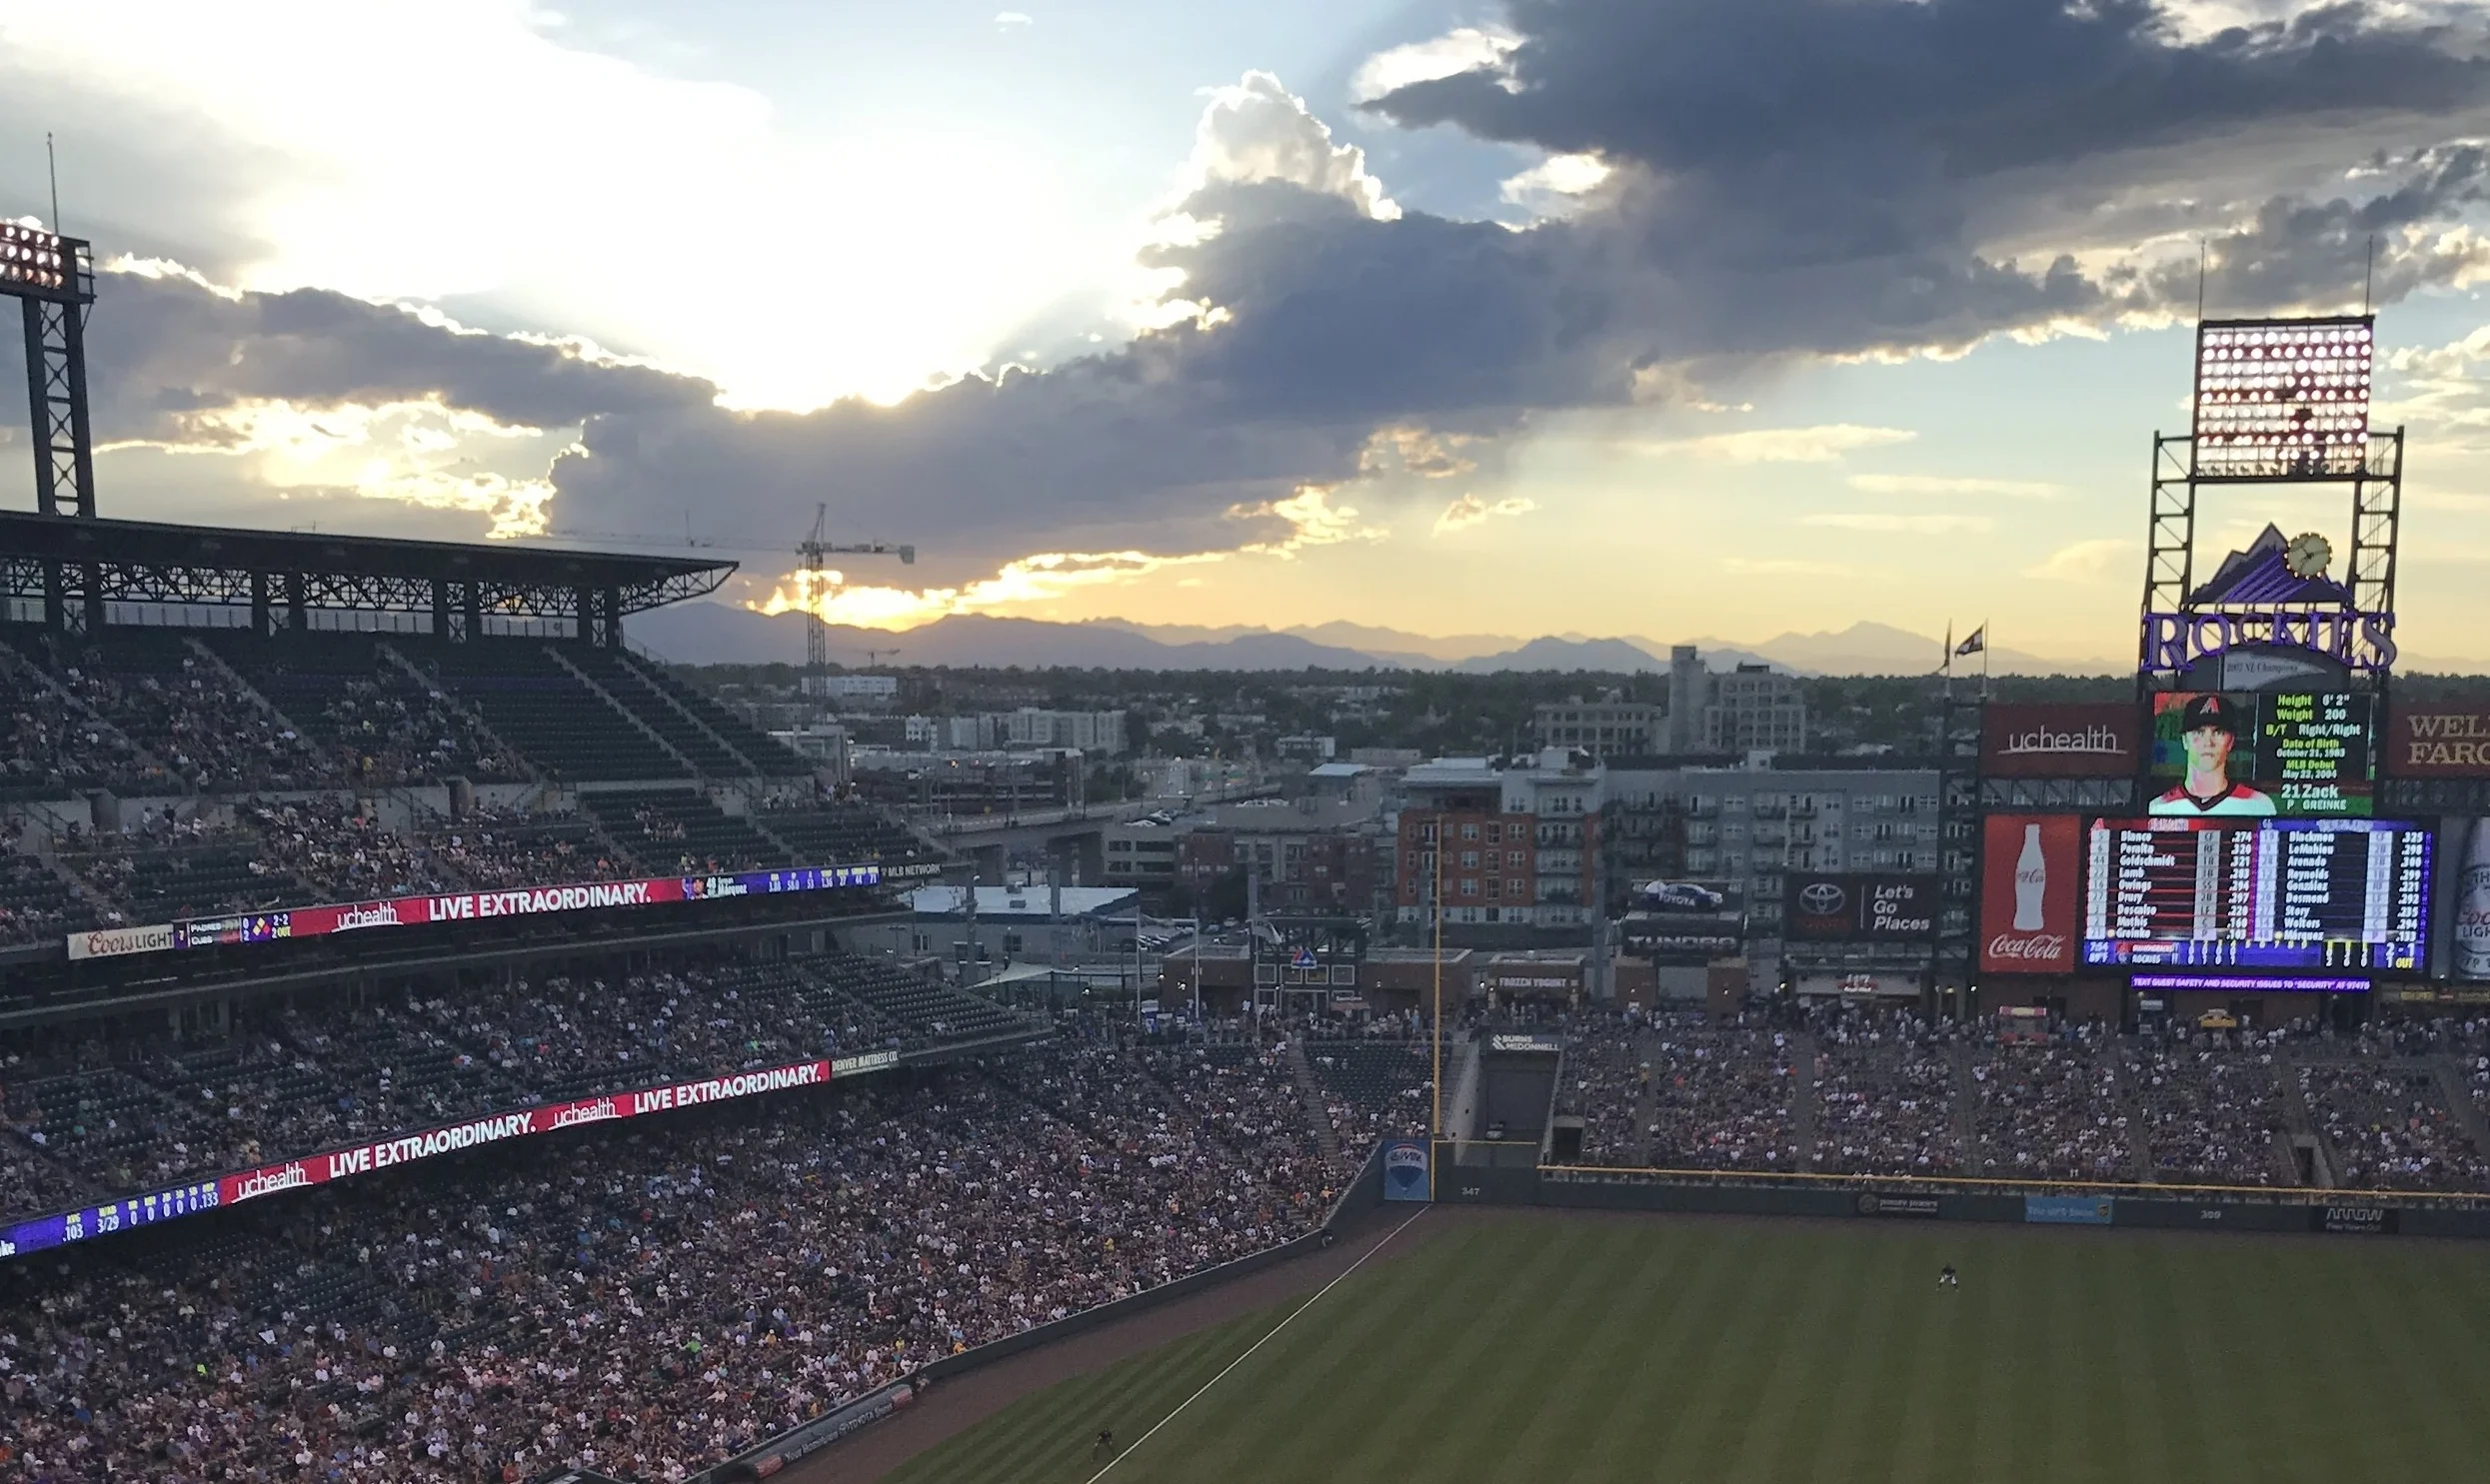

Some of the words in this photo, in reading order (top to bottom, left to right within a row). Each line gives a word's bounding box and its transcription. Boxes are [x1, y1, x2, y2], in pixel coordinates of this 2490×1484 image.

[2142, 613, 2398, 672] ROCKIES
[2277, 695, 2312, 708] Height
[2322, 695, 2333, 706] 6'
[2335, 695, 2350, 706] 2"
[2277, 710, 2313, 722] Weight
[2325, 710, 2347, 720] 200
[2265, 724, 2287, 738] B/T
[2299, 724, 2361, 738] Right/Right
[2407, 715, 2490, 738] WEL
[2009, 725, 2117, 750] uchealth
[2277, 748, 2309, 757] October
[2325, 748, 2345, 757] 1983
[2286, 760, 2306, 769] MLB
[2308, 760, 2335, 769] Debut
[2282, 769, 2299, 780] May
[2315, 769, 2337, 778] 2004
[2281, 783, 2300, 798] 21
[2301, 783, 2339, 798] Zack
[2287, 799, 2294, 809] P
[2303, 799, 2347, 809] GREINKE
[2120, 831, 2152, 841] Blanco
[2232, 831, 2252, 842] .274
[2289, 831, 2335, 842] Blackmon
[2402, 831, 2423, 842] .325
[2120, 843, 2154, 853] Peralta
[2231, 843, 2251, 854] .320
[2289, 843, 2334, 854] LeMahieu
[2119, 855, 2175, 866] Goldschmidt
[2231, 856, 2250, 866] .321
[2288, 856, 2327, 866] Arenado
[2401, 856, 2422, 867] .300
[889, 866, 904, 877] MLB
[905, 865, 942, 875] NETWORK
[2119, 867, 2145, 877] Lamb
[2287, 868, 2329, 881] Reynolds
[2400, 869, 2421, 880] .299
[1874, 884, 1913, 899] Let's
[2118, 880, 2151, 892] Owings
[2399, 881, 2419, 892] .221
[429, 895, 474, 921] LIVE
[479, 882, 652, 917] EXTRAORDINARY.
[1659, 893, 1695, 906] TOYOTA
[2118, 892, 2143, 904] Drury
[2286, 893, 2329, 903] Desmond
[2398, 893, 2419, 904] .292
[1873, 900, 1897, 914] Go
[2117, 904, 2157, 915] Descalso
[2285, 906, 2310, 918] Story
[2397, 906, 2418, 917] .235
[273, 914, 289, 925] 2-2
[337, 901, 397, 929] uchealth
[190, 922, 221, 932] PADRES
[243, 918, 249, 927] 0
[1873, 916, 1930, 930] Places
[2117, 917, 2148, 927] Mathis
[2284, 918, 2321, 929] Wolters
[2397, 918, 2418, 929] .294
[243, 930, 249, 941] 2
[272, 929, 277, 939] 2
[277, 926, 291, 937] OUT
[2116, 928, 2151, 938] Greinke
[2396, 930, 2417, 941] .133
[87, 931, 133, 955] Coors
[136, 931, 174, 948] LIGHT
[1989, 933, 2066, 959] Coca-Cola
[2386, 942, 2394, 956] 2
[2407, 942, 2415, 957] 1
[2386, 957, 2392, 968] 1
[2396, 957, 2413, 968] OUT
[1499, 977, 1531, 986] FROZEN
[1533, 978, 1566, 987] YOGURT
[2133, 977, 2151, 986] TEXT
[2151, 978, 2175, 987] GUEST
[2176, 978, 2202, 987] SAFETY
[2221, 979, 2255, 988] SECURITY
[2336, 980, 2346, 989] AT
[832, 1057, 857, 1071] DENVER
[858, 1052, 888, 1066] MATTRESS
[889, 1051, 899, 1061] CO.
[554, 1097, 616, 1125] uchealth
[634, 1089, 673, 1114] LIVE
[677, 1063, 821, 1106] EXTRAORDINARY.
[237, 1161, 306, 1198] uchealth
[329, 1148, 371, 1178] LIVE
[375, 1112, 537, 1168] EXTRAORDINARY.
[63, 1223, 84, 1242] .103
[97, 1215, 119, 1233] 3/29
[130, 1211, 137, 1225] 0
[148, 1207, 154, 1221] 0
[164, 1203, 170, 1217] 0
[177, 1200, 184, 1214] 0
[190, 1197, 197, 1211] 0
[200, 1192, 218, 1209] .133
